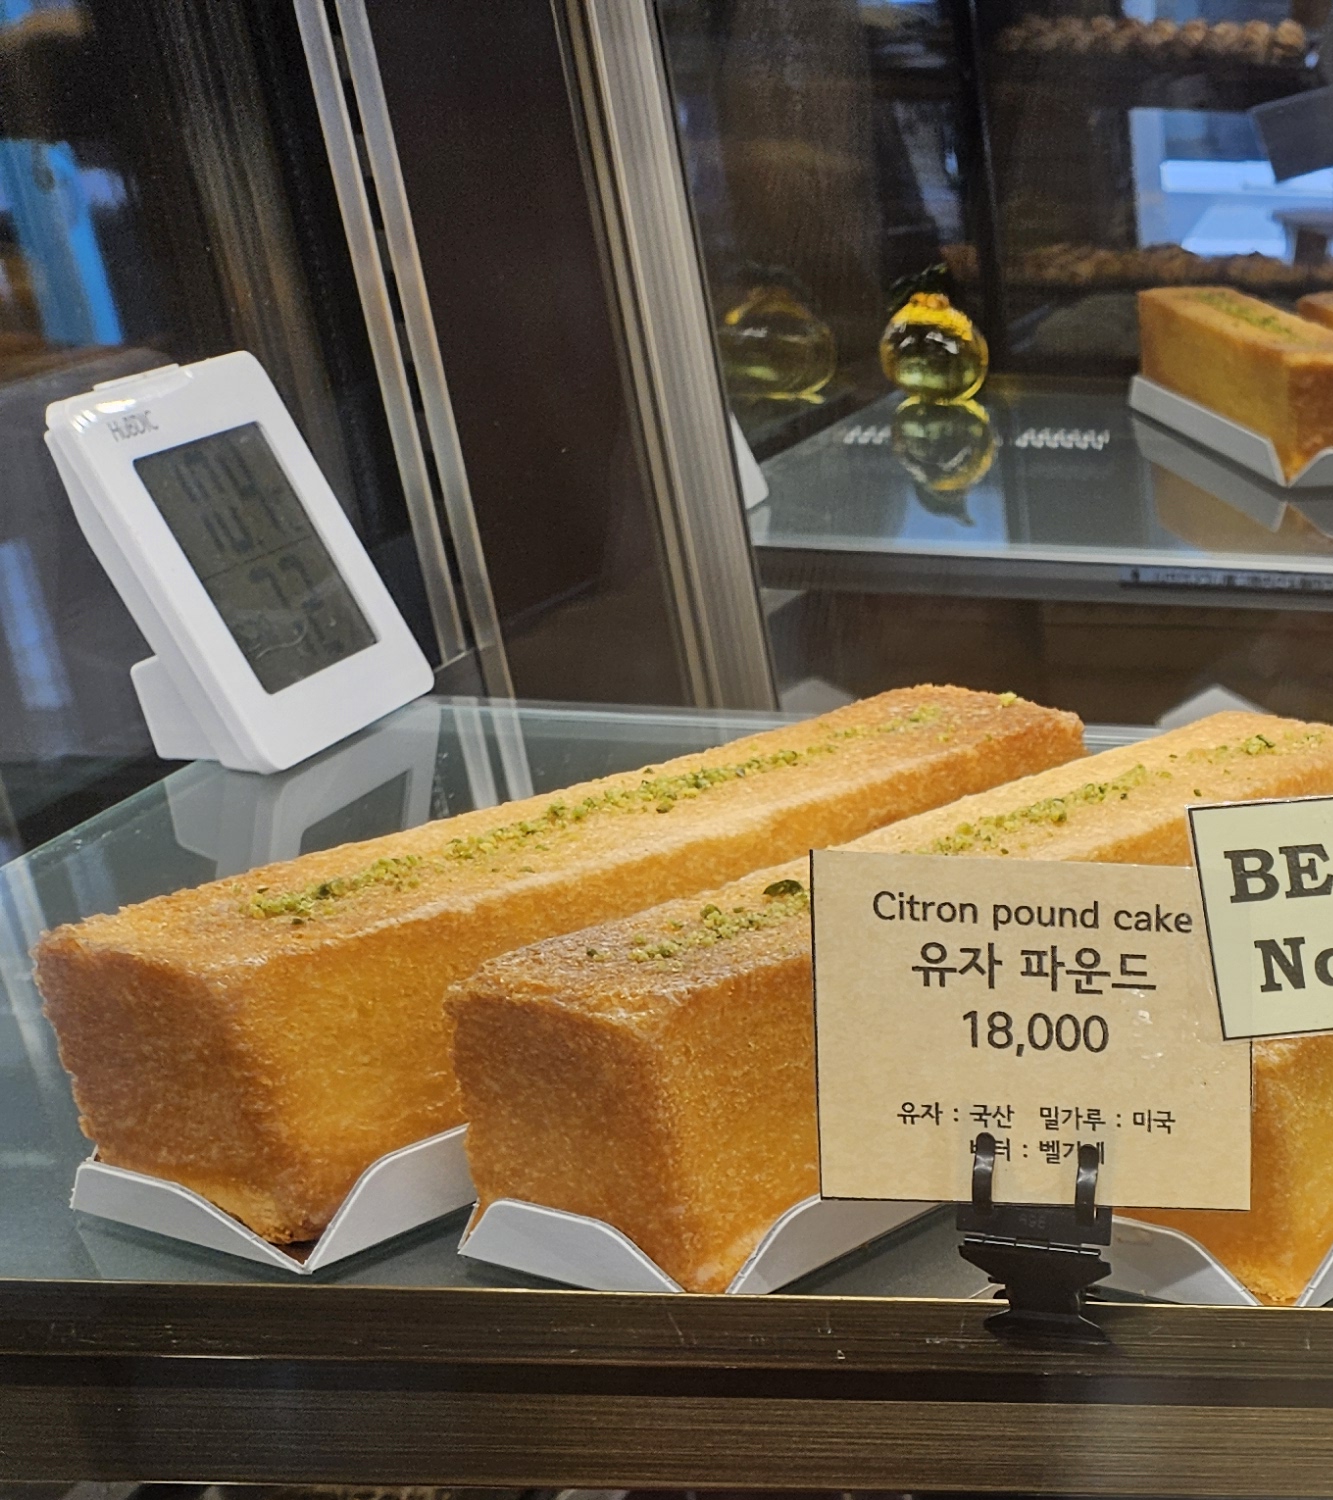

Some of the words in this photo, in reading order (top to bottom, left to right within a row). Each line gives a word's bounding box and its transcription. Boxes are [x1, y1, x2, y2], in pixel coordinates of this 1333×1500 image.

[872, 890, 978, 925] Citron
[992, 897, 1100, 932] pound
[1113, 903, 1193, 934] cake
[911, 940, 1003, 991] 유자
[1018, 946, 1158, 996] 파운드
[961, 1009, 1110, 1058] 18,000
[897, 1101, 943, 1126] 유자
[953, 1107, 960, 1122] :
[969, 1104, 1015, 1129] 국산
[1039, 1105, 1106, 1132] 밀가루
[1116, 1113, 1122, 1128] :
[1133, 1109, 1176, 1134] 미국
[970, 1137, 1011, 1162] 터
